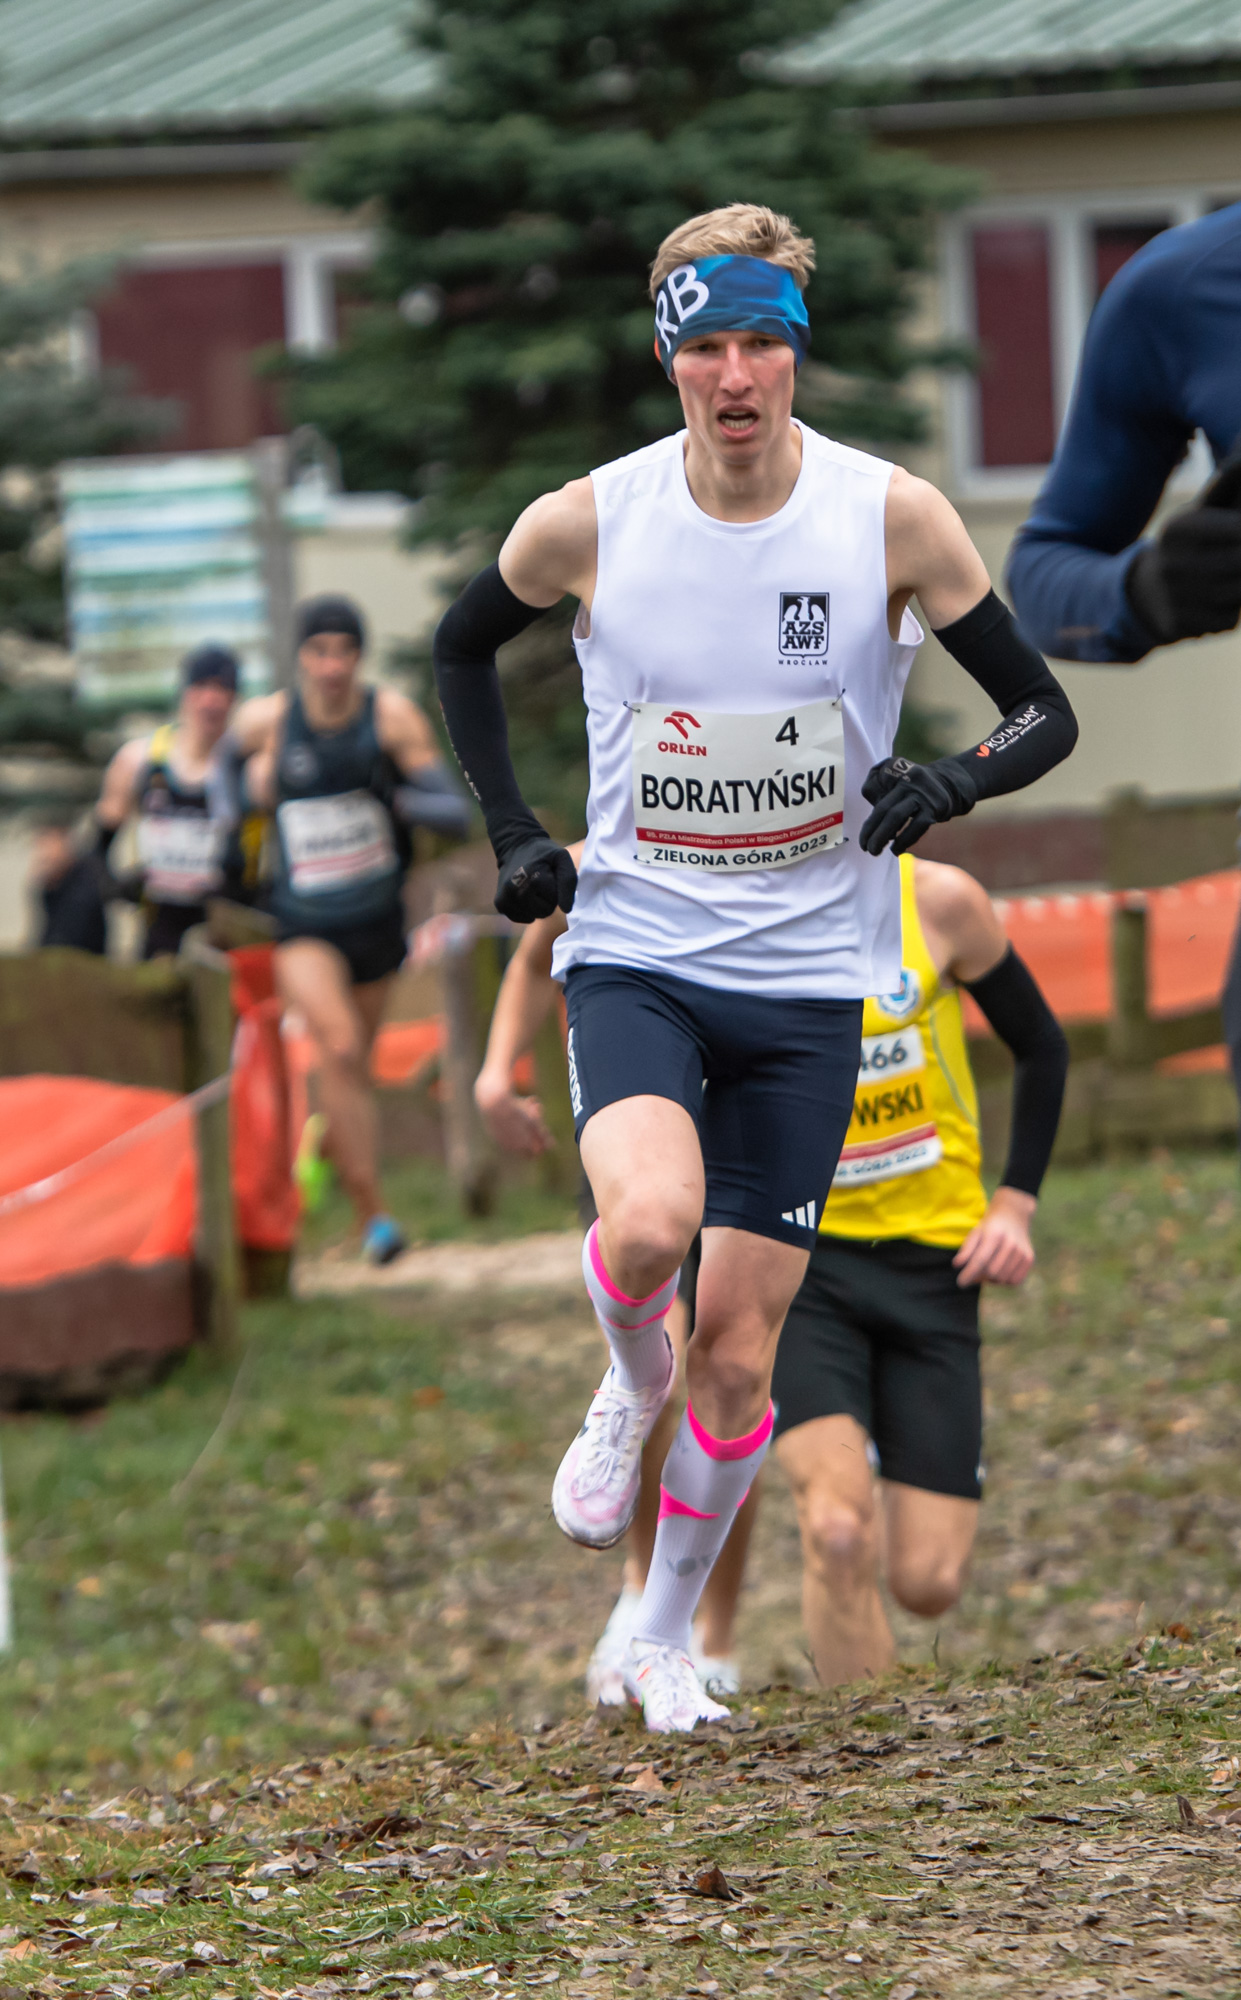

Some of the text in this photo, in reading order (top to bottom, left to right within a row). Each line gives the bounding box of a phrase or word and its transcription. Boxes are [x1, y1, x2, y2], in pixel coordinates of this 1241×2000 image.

[782, 621, 825, 635] AZS
[782, 635, 825, 649] AWF
[775, 715, 800, 746] 4
[985, 724, 1023, 748] ROYAL
[657, 740, 708, 757] ORLEN
[640, 765, 836, 814] BORATYŃSKI
[653, 833, 828, 867] ZIELONA GÓRA 2023
[677, 834, 724, 845] Mistrzostwa
[724, 836, 748, 845] Polski
[756, 831, 789, 843] Biegach
[849, 1082, 925, 1127] WSKI
